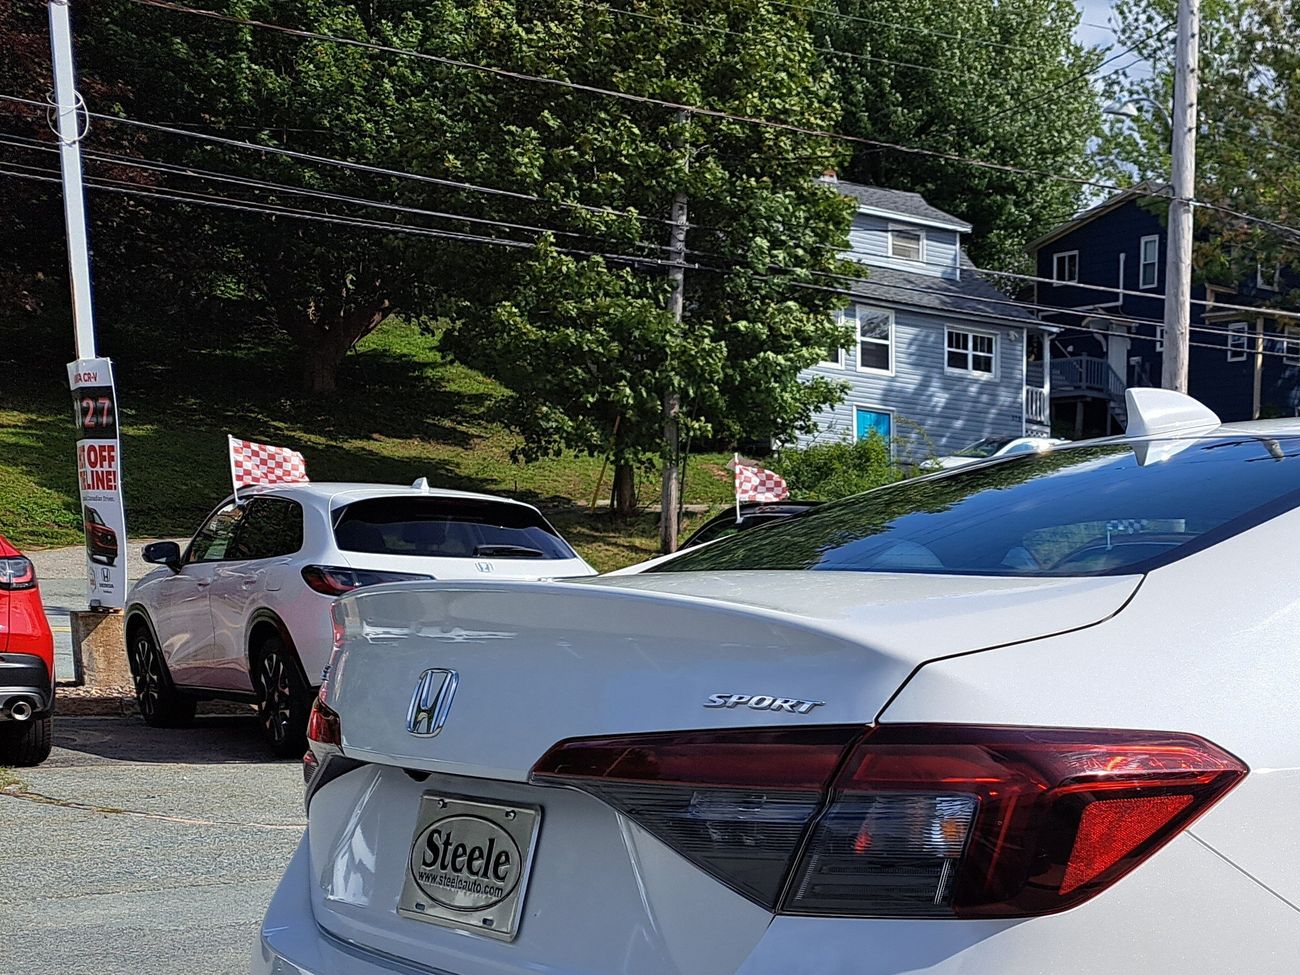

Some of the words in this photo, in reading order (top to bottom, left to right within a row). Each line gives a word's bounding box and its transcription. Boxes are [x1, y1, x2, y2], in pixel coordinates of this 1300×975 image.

[87, 444, 116, 469] OFF
[703, 693, 826, 715] SPORT
[422, 828, 511, 883] Steele
[418, 870, 503, 898] www.steeleauto.com
